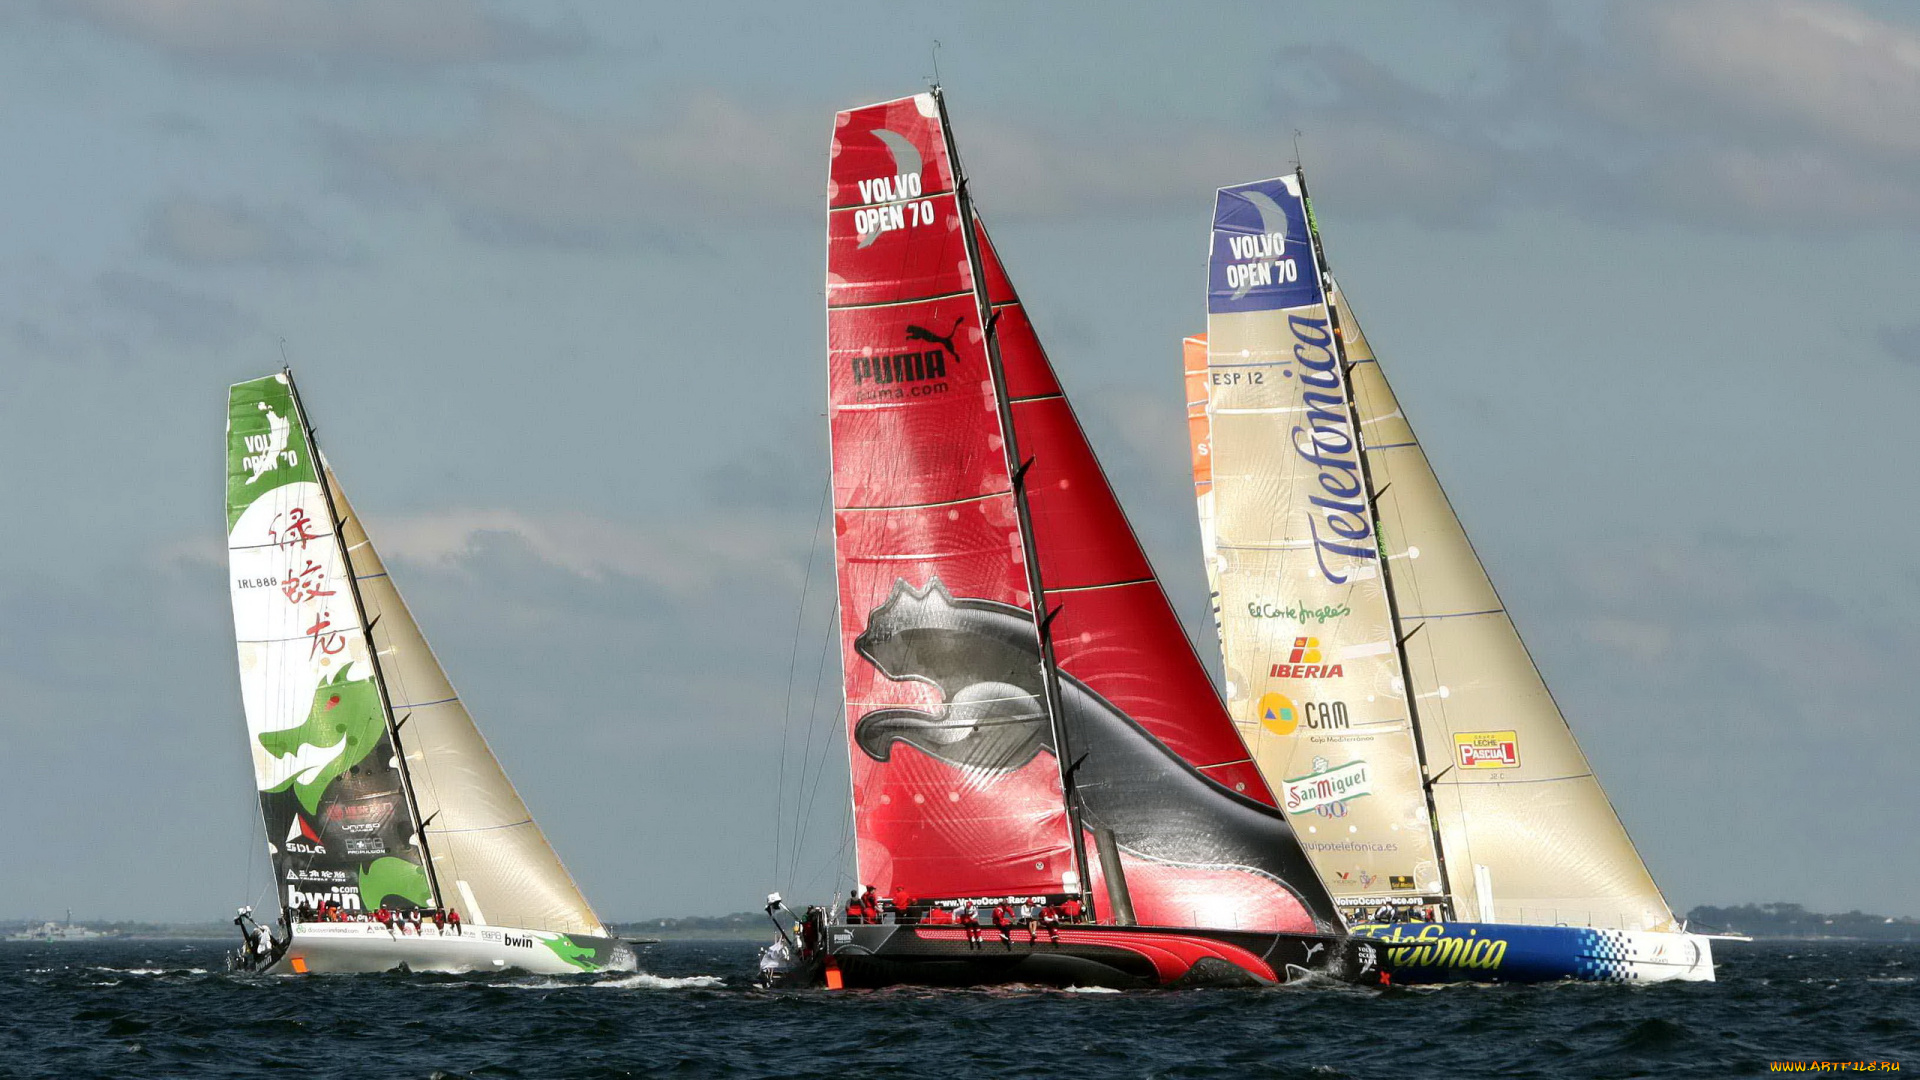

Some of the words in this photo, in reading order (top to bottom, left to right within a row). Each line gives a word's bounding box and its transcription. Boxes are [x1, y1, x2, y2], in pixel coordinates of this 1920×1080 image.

[858, 173, 922, 204] VOLVO
[855, 205, 905, 234] OPEN
[908, 200, 934, 228] 70
[1229, 232, 1285, 259] VOLVO
[1227, 263, 1272, 288] OPEN
[1275, 259, 1297, 284] 70
[852, 350, 946, 386] PUMA
[1212, 373, 1241, 385] ESP
[1248, 372, 1263, 384] 12
[857, 382, 948, 402] puma.com
[238, 577, 277, 589] IRL888
[1248, 602, 1263, 618] El
[1263, 604, 1297, 618] Corte
[1269, 664, 1343, 678] IBERIA
[1305, 701, 1350, 729] CAM
[286, 842, 327, 854] SDLG
[1301, 841, 1397, 852] quipotelefonica.es
[288, 884, 361, 910] bwin
[505, 934, 533, 948] bwin
